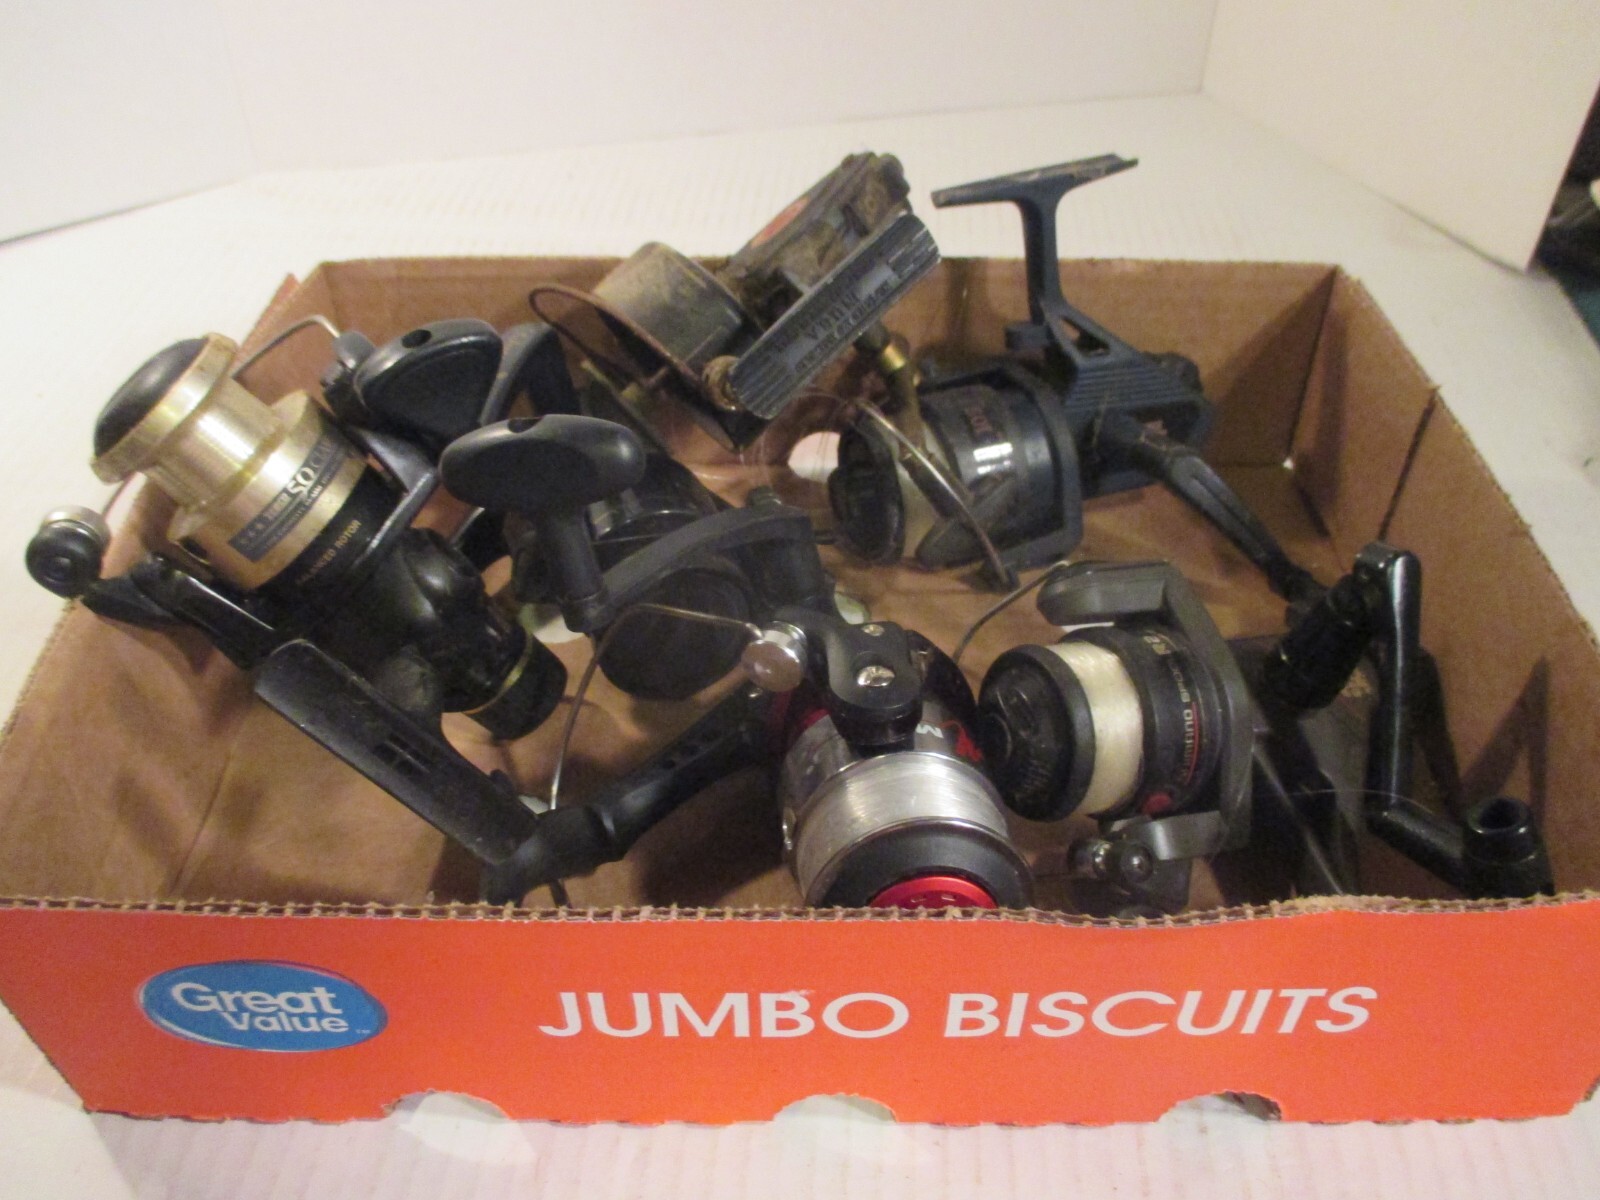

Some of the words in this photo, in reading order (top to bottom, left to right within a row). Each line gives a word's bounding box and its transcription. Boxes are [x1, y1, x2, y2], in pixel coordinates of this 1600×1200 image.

[171, 982, 343, 1015] Great
[537, 991, 910, 1039] JUMBO
[943, 986, 1378, 1039] BISCUITS
[219, 1011, 350, 1033] Value
